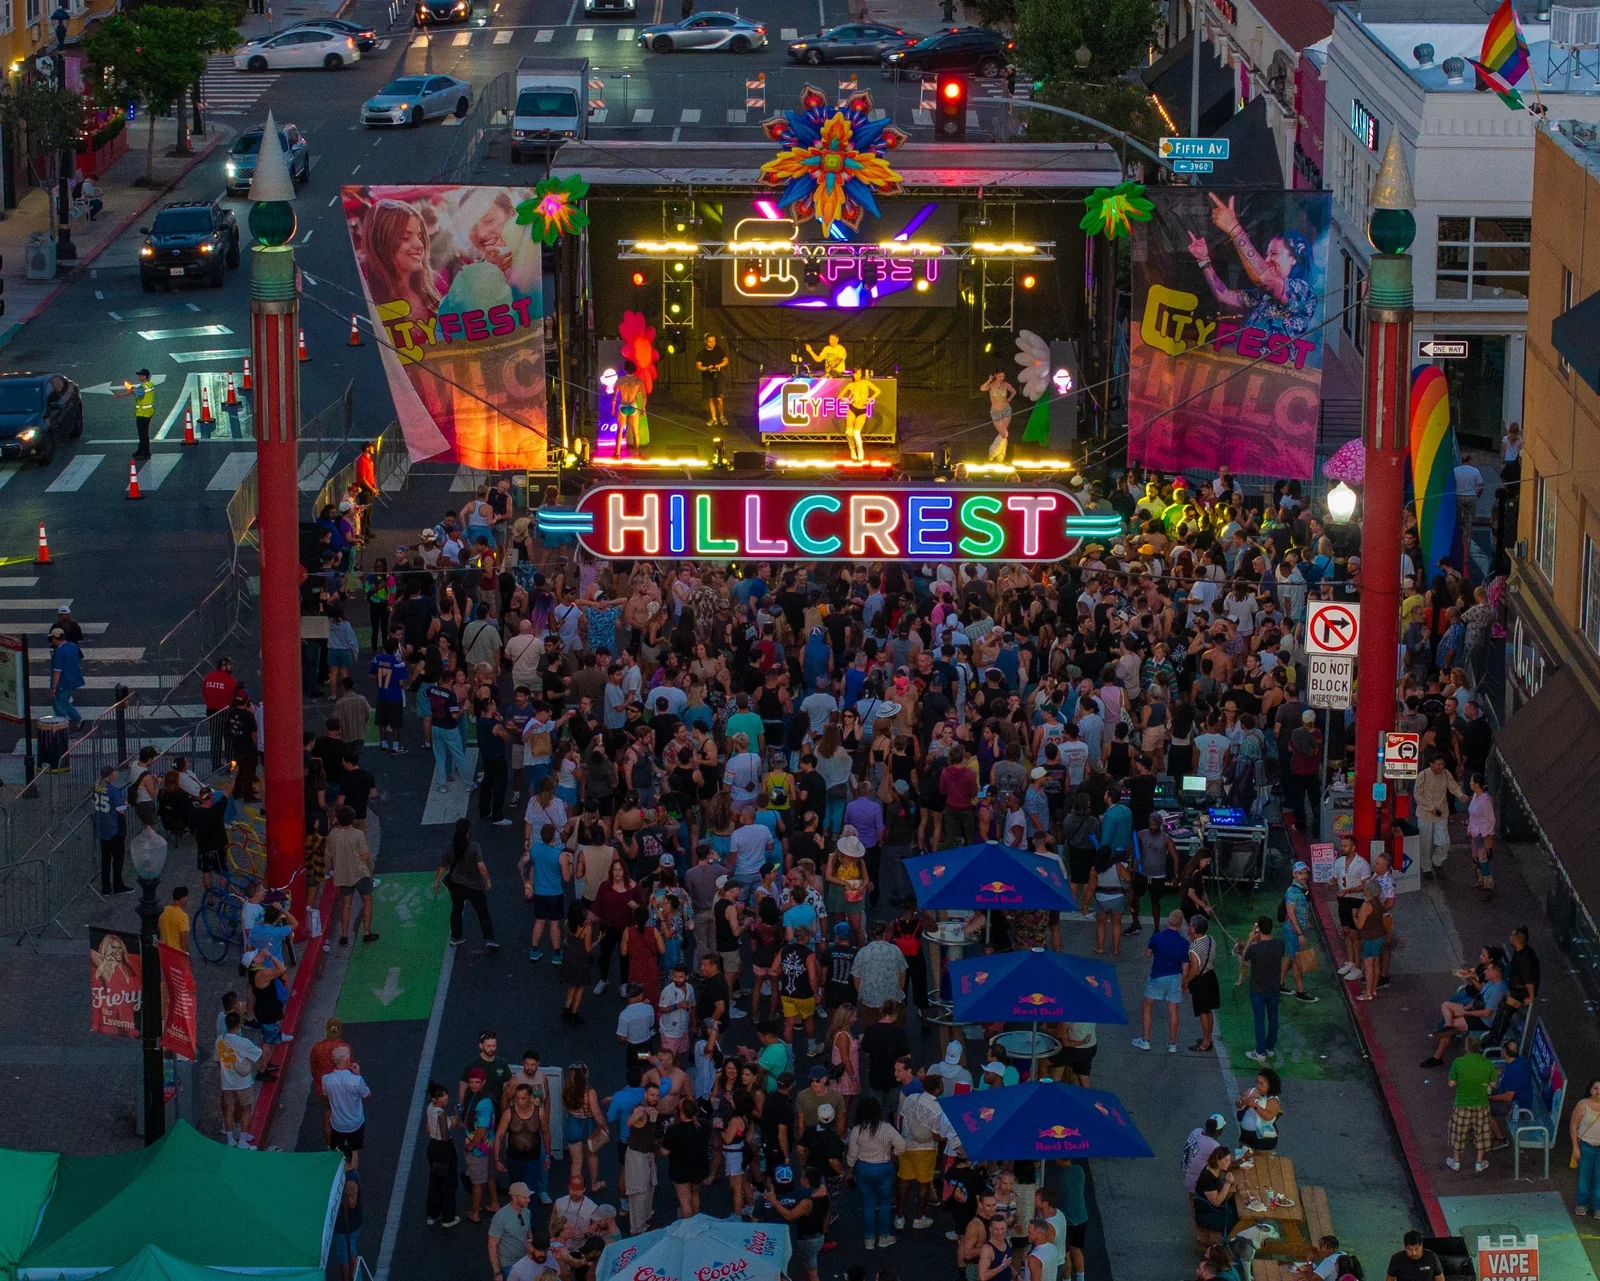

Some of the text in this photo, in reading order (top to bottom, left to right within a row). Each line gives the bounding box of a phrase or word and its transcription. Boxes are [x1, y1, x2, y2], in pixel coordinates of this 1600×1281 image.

[1175, 142, 1204, 154] FIFTH
[1140, 284, 1316, 370] CITYFEST
[781, 382, 876, 427] CITYFET
[607, 493, 1058, 557] HILLCREST
[1312, 661, 1350, 675] DO NOT
[206, 681, 225, 690] ELITE
[1311, 678, 1349, 692] BLOCK
[92, 987, 142, 1011] Fiery
[1012, 1006, 1063, 1016] Red Bull
[103, 1016, 135, 1029] Laverne
[1035, 1140, 1089, 1151] Red Bull
[694, 1258, 749, 1281] Coors
[1487, 1253, 1530, 1275] VAPE
